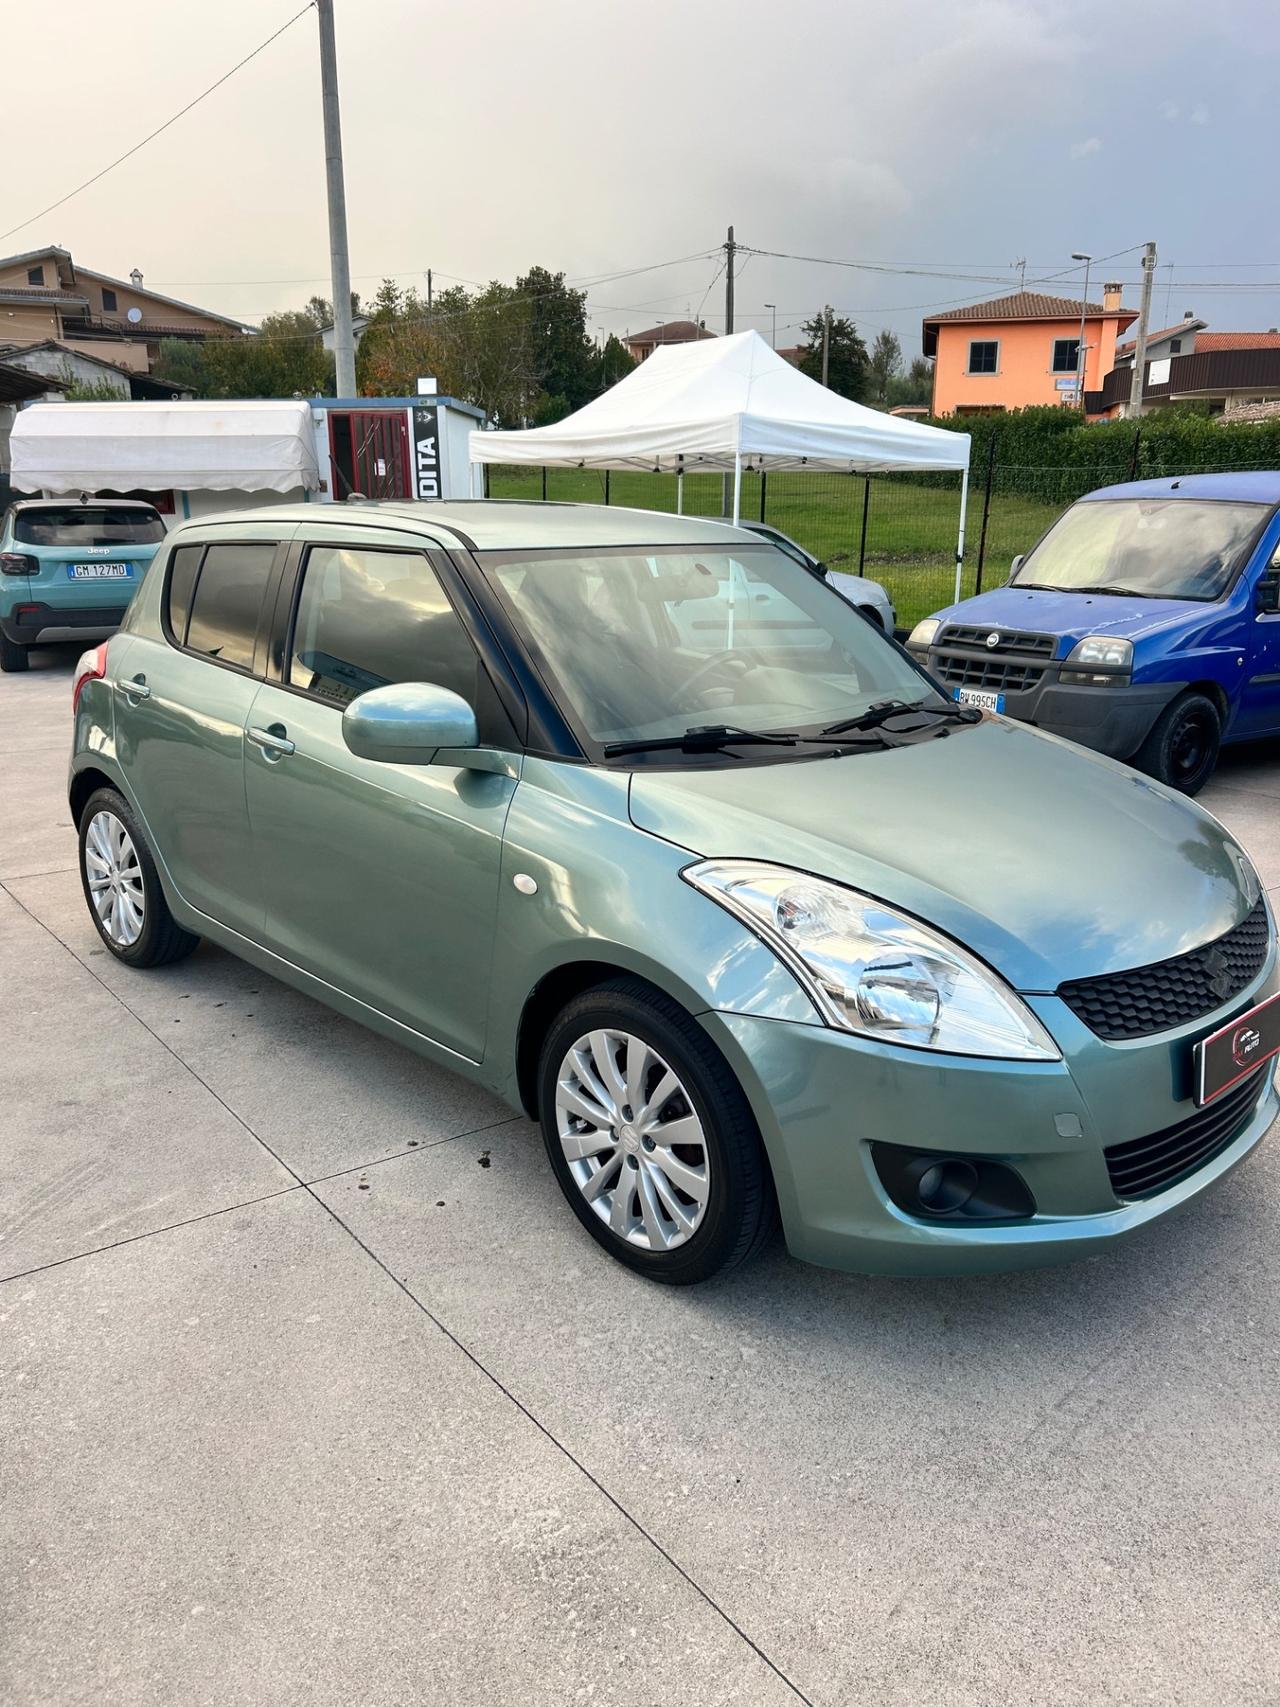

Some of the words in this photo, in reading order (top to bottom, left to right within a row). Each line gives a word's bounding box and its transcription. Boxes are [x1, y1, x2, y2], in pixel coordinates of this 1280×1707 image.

[417, 436, 439, 499] DITA
[87, 547, 110, 555] Jeep
[93, 564, 125, 577] 127MD
[971, 694, 997, 709] 995CH
[1244, 1038, 1260, 1054] AUTO
